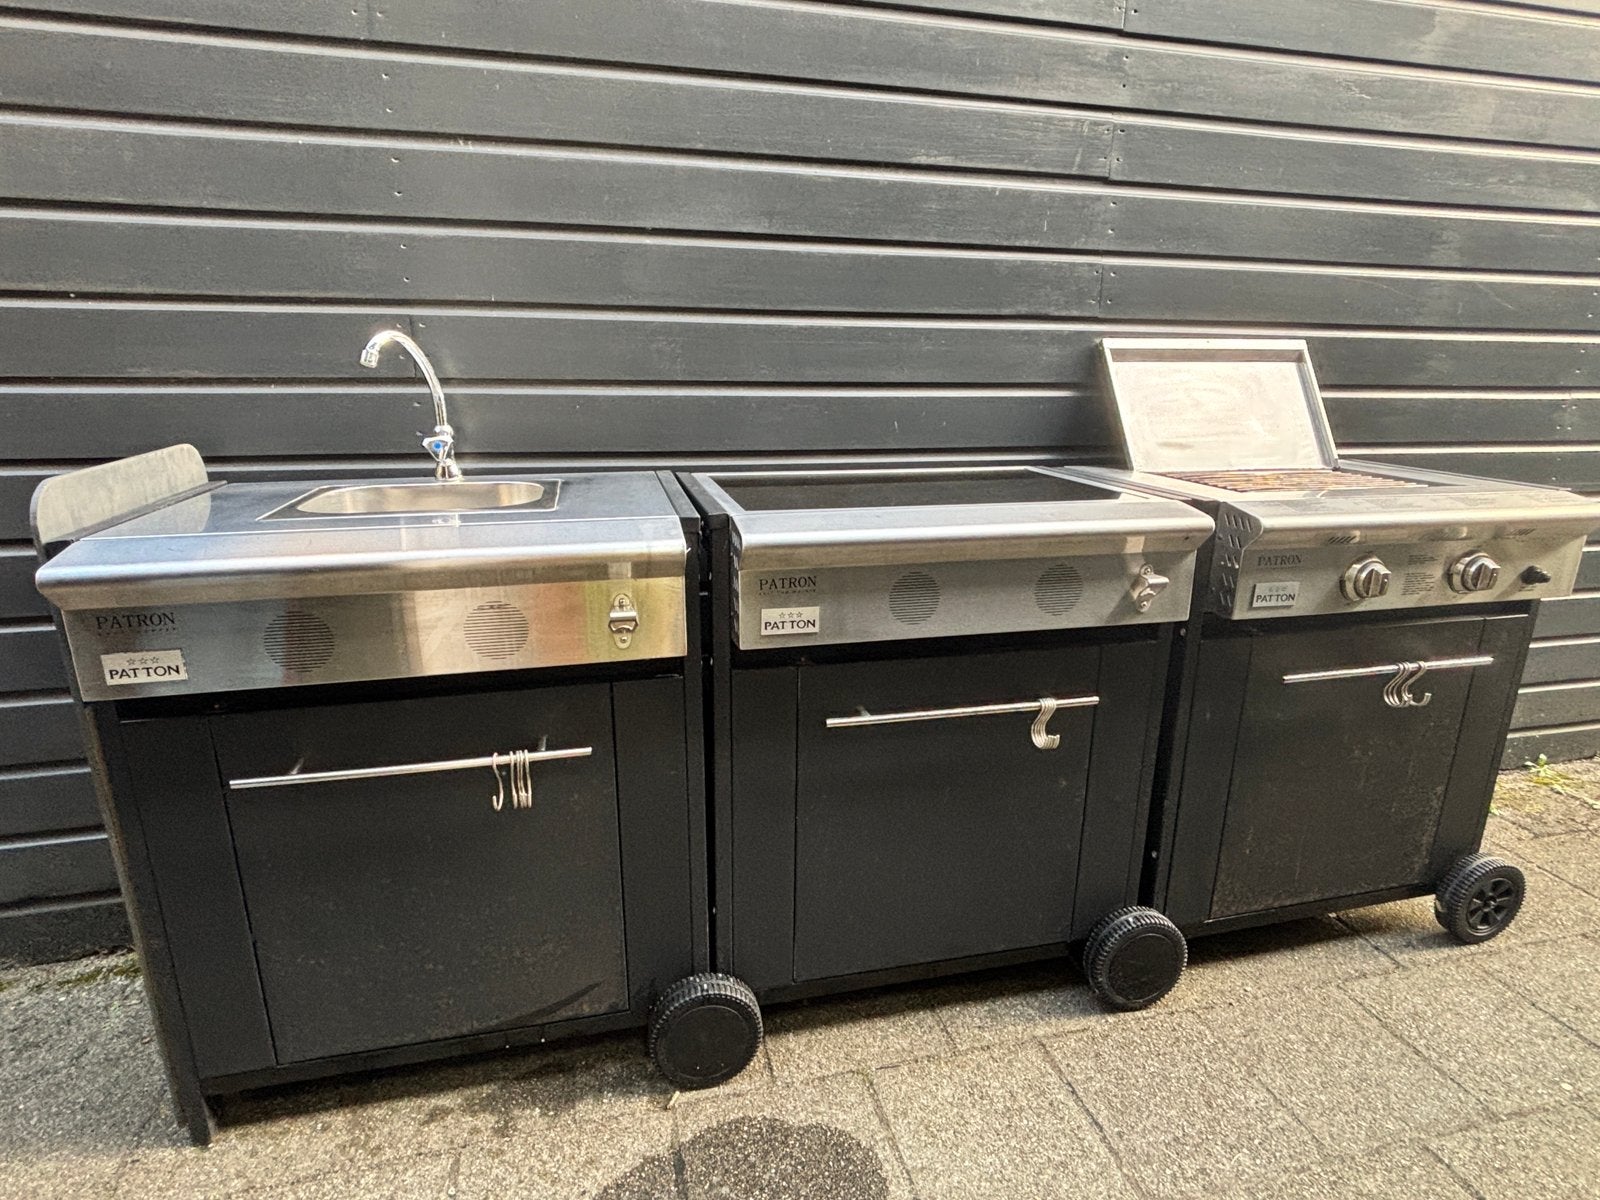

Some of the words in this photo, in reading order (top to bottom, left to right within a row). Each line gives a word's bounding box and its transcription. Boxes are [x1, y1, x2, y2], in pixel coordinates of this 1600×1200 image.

[1257, 554, 1302, 566] PATRON
[759, 576, 817, 590] PATRON
[1256, 593, 1296, 603] PATTON
[96, 612, 175, 630] PATRON
[764, 619, 816, 631] PATTON
[109, 665, 180, 680] PATTON
